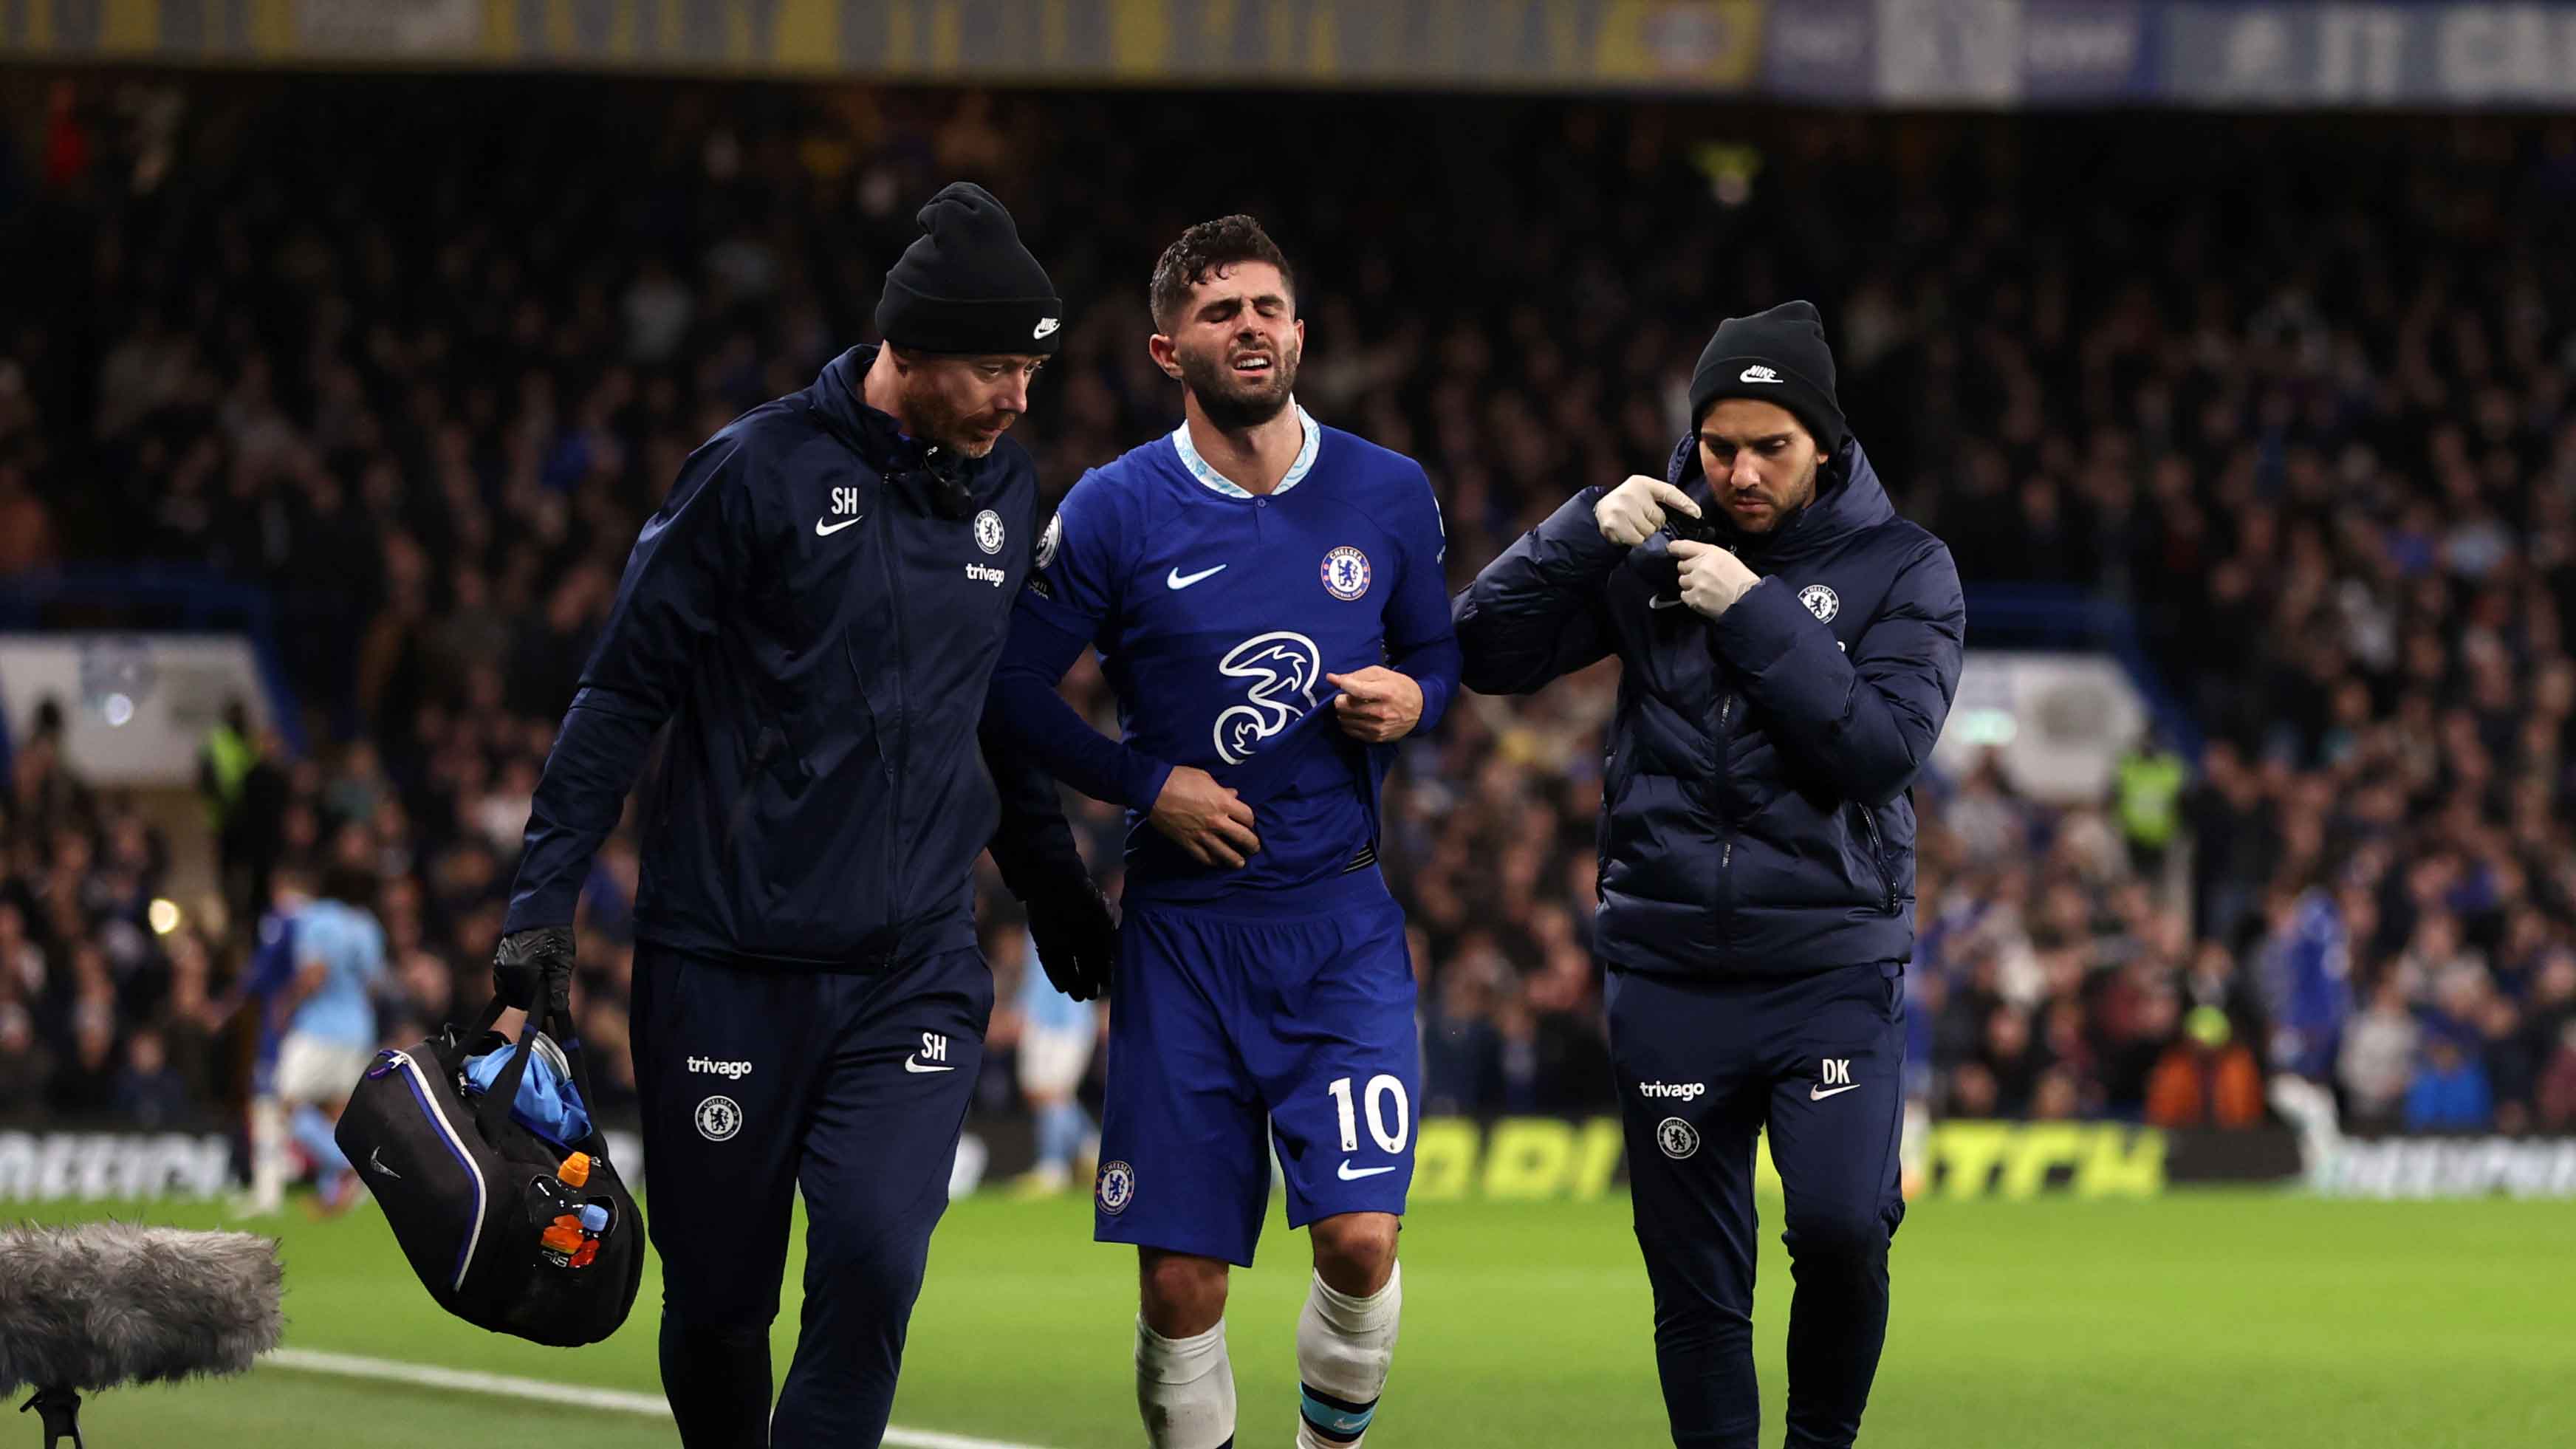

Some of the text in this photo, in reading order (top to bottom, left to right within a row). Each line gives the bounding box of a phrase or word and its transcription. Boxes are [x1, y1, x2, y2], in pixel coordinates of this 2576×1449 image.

[1748, 365, 1776, 379] NIKE
[831, 487, 857, 515] SH
[1329, 548, 1363, 561] CHELSEA
[965, 563, 1004, 587] trivago
[1803, 586, 1832, 597] CHELSEA
[921, 1032, 947, 1061] SH
[687, 1056, 753, 1080] trivago
[1822, 1058, 1850, 1084] DK
[1639, 1080, 1705, 1101] trivago
[704, 1098, 733, 1109] CHELSEA
[1328, 1074, 1409, 1154] 10
[1104, 1162, 1130, 1176] CHELSEA
